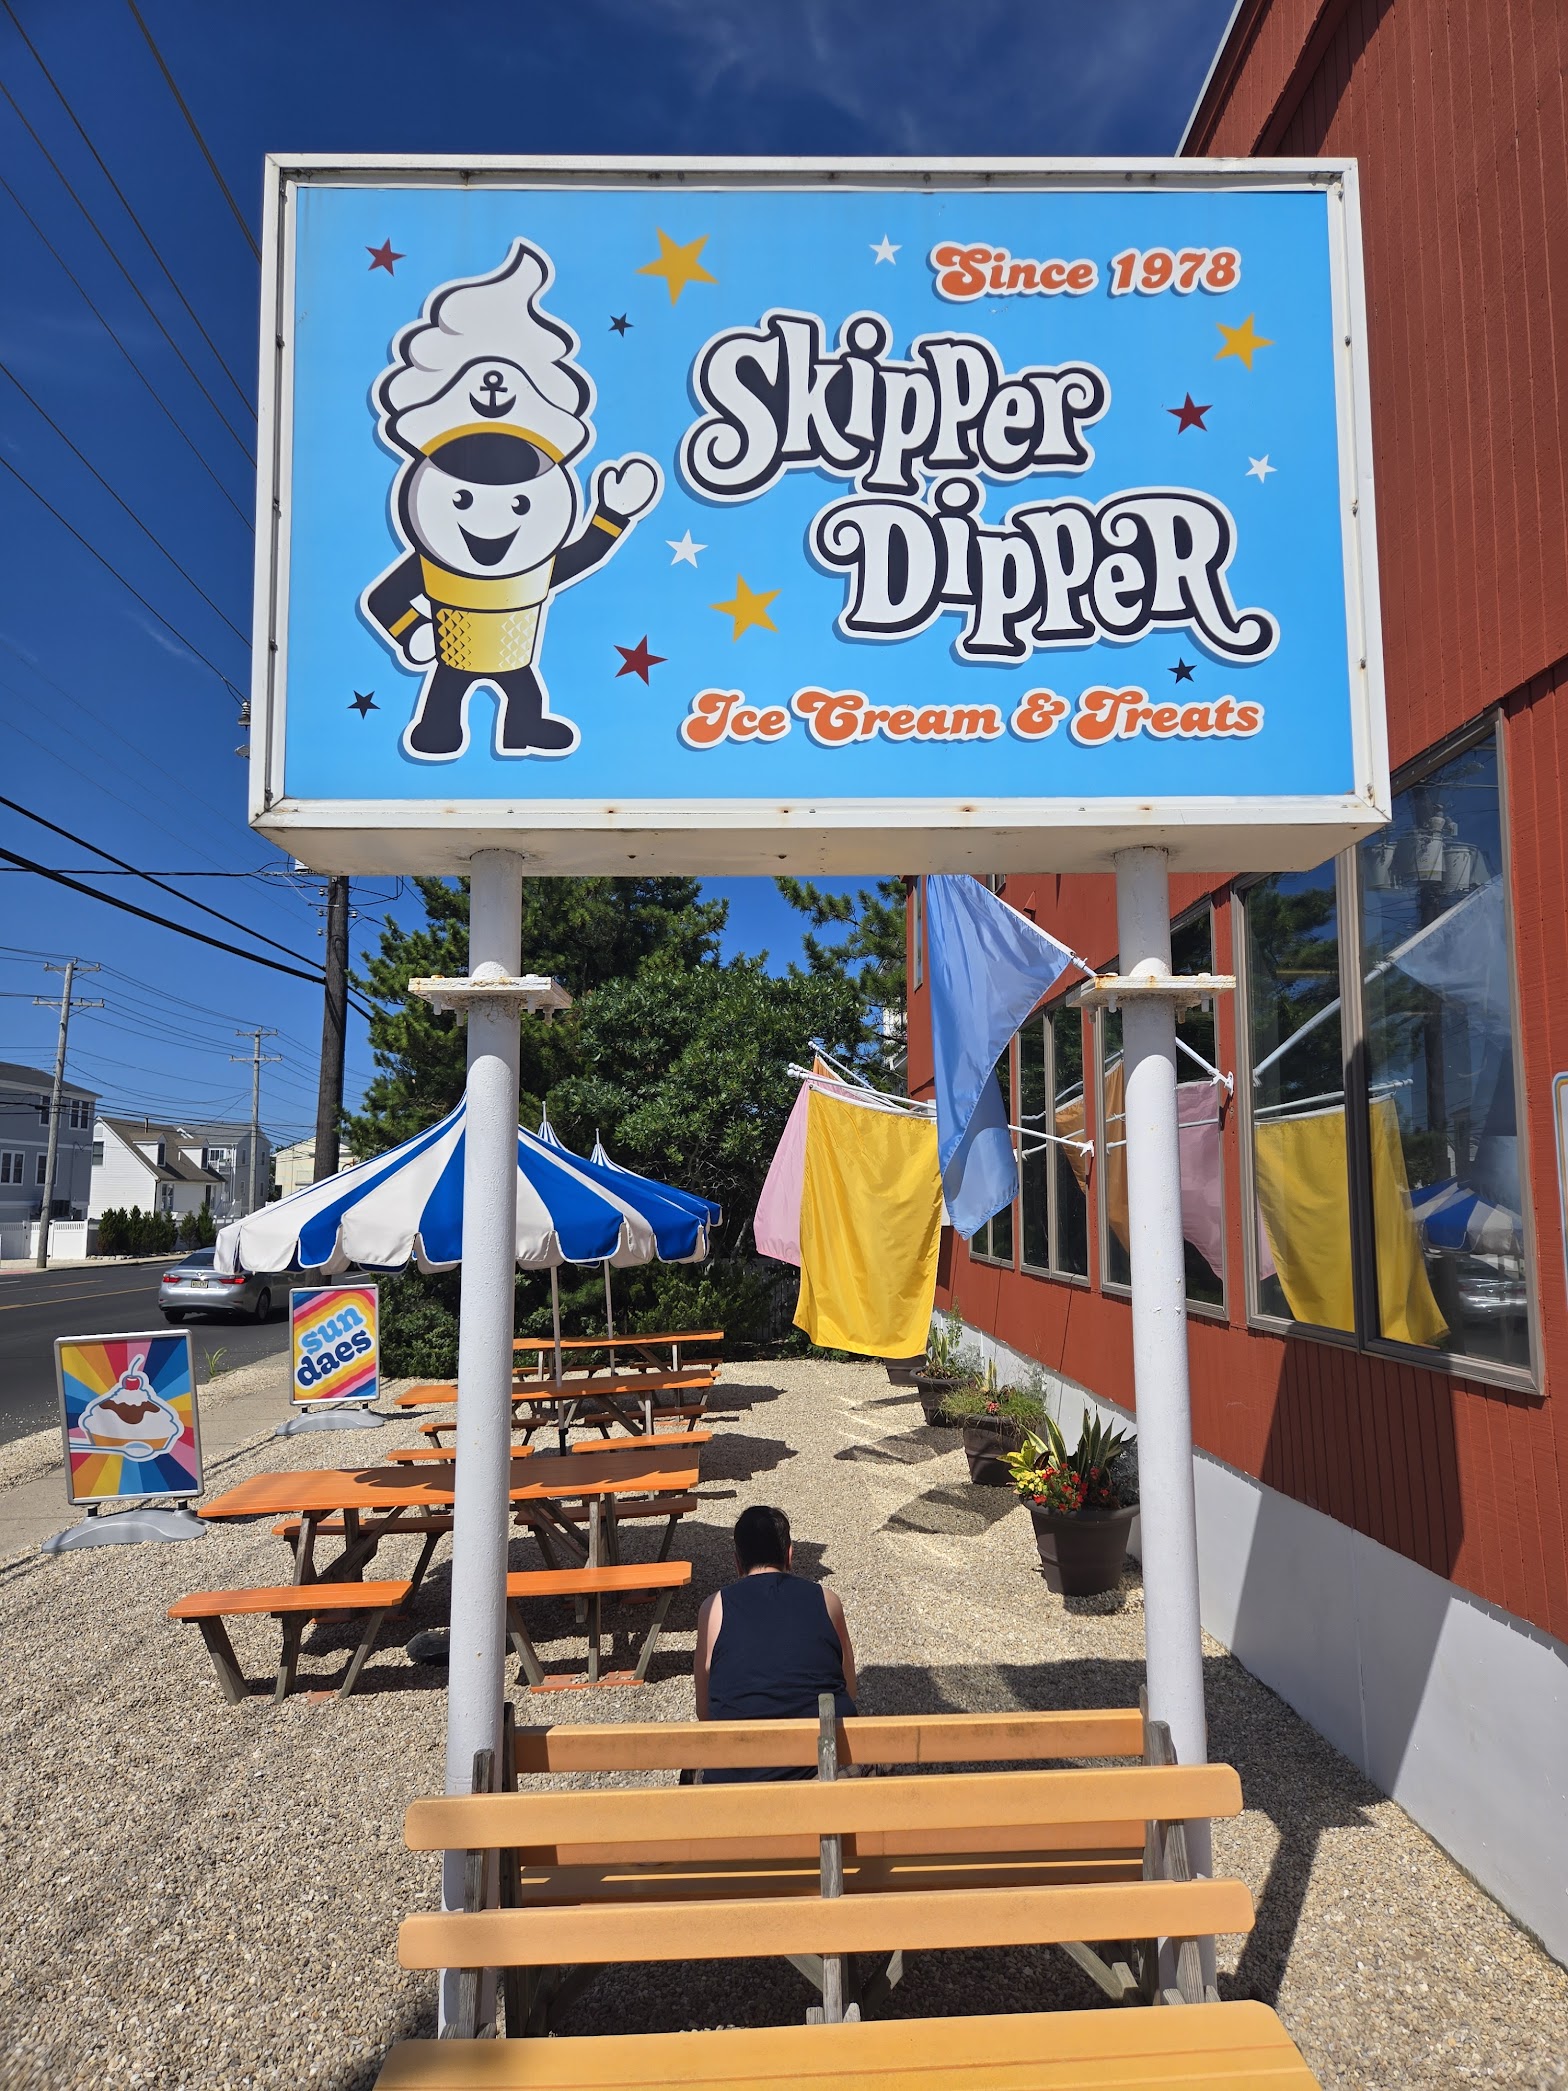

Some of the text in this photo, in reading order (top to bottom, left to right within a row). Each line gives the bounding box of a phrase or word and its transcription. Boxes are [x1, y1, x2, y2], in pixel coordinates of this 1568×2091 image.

[935, 246, 1238, 296] Since 1978
[687, 314, 1105, 495] Skipper
[681, 690, 1260, 744] Ice Cream & Treats
[297, 1329, 371, 1386] daes
[301, 1307, 363, 1355] sun
